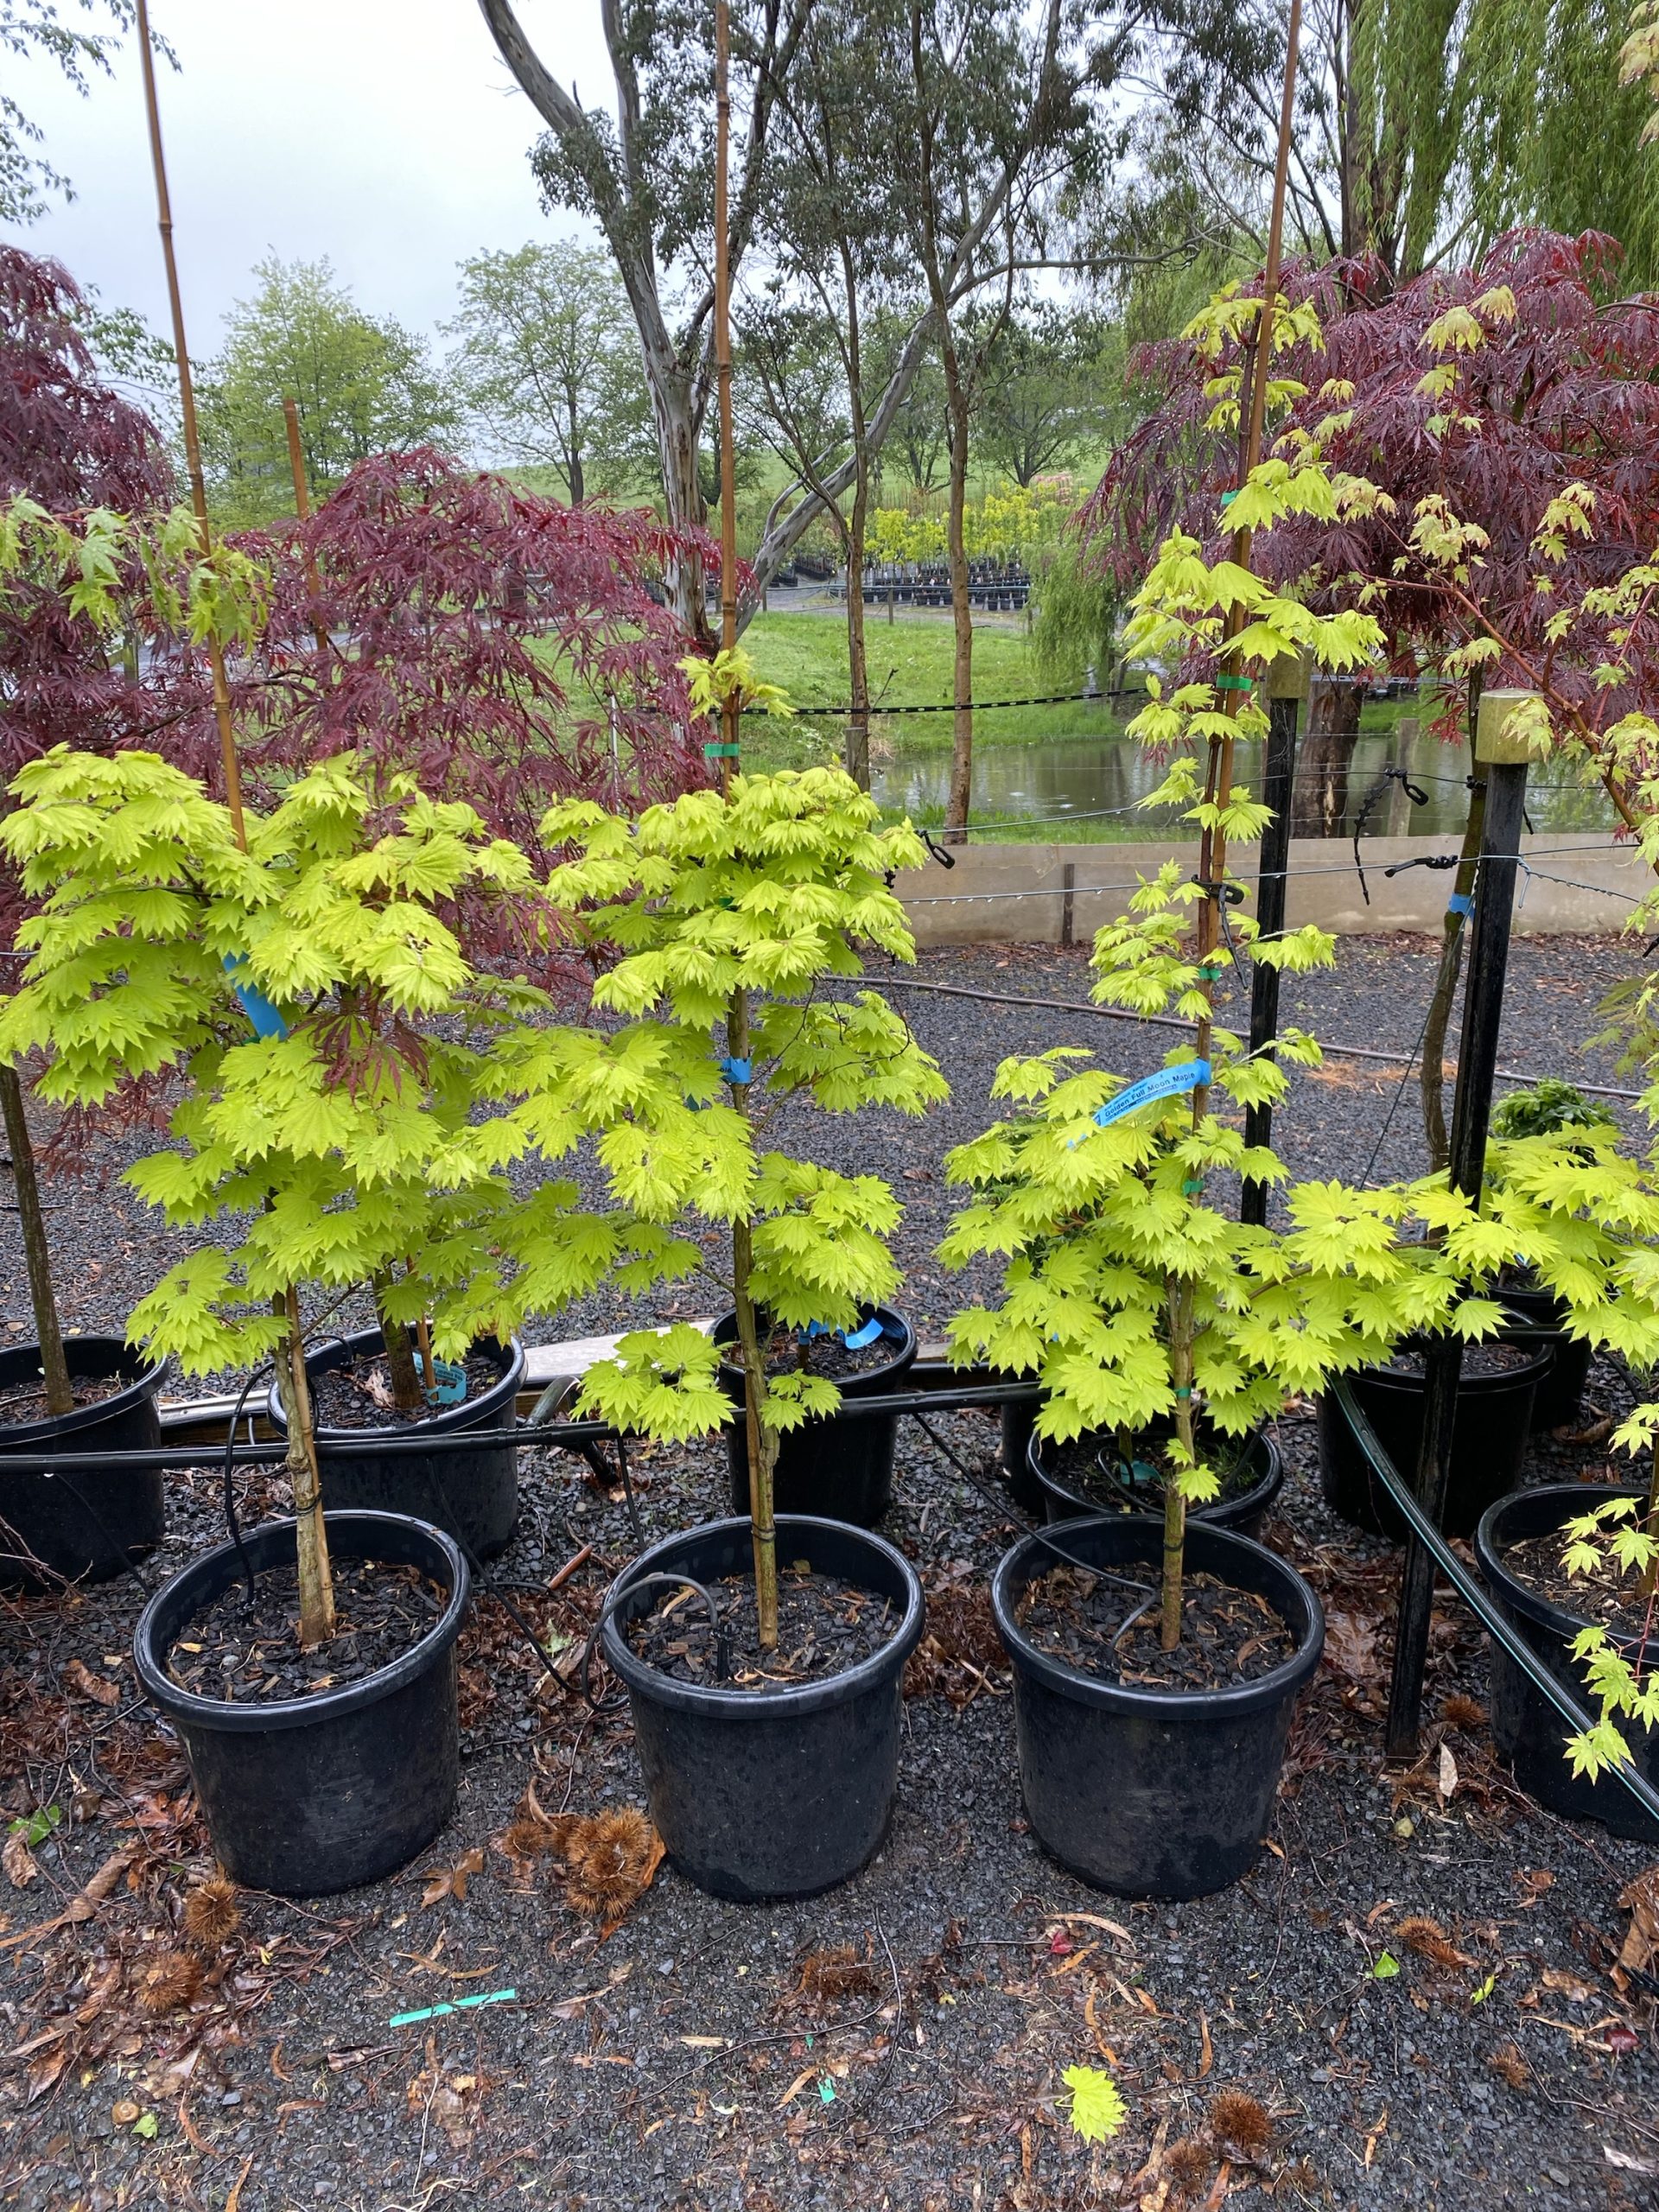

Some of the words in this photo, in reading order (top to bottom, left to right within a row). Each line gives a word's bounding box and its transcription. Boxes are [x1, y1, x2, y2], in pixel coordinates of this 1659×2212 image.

[1105, 1099, 1129, 1116] Golden
[1131, 1089, 1145, 1100] Full
[1147, 1079, 1170, 1090] Moon
[1173, 1072, 1195, 1082] Maple
